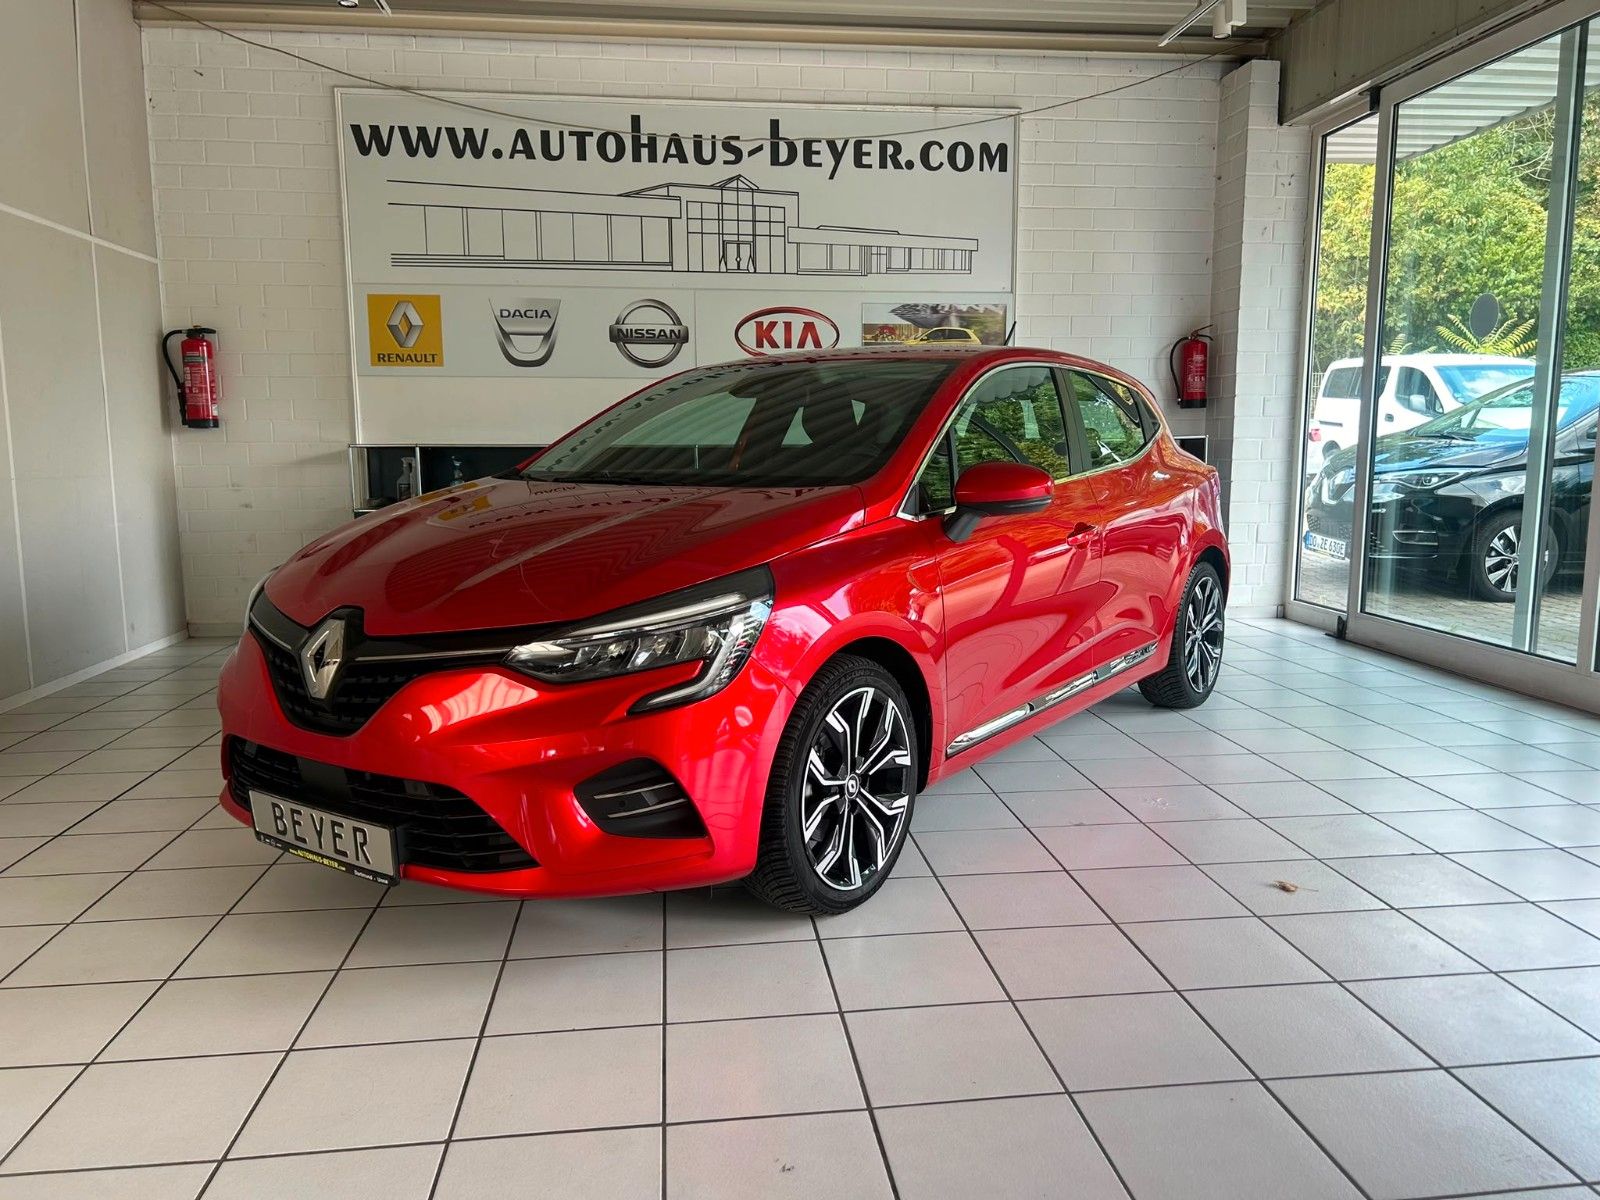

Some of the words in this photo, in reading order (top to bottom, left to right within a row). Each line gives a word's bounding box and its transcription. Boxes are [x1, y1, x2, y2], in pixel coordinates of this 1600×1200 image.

[500, 308, 552, 320] DACIA
[616, 327, 682, 341] NISSAN
[754, 320, 823, 350] KIA
[377, 352, 437, 365] RENAULT
[271, 801, 373, 865] BEYER
